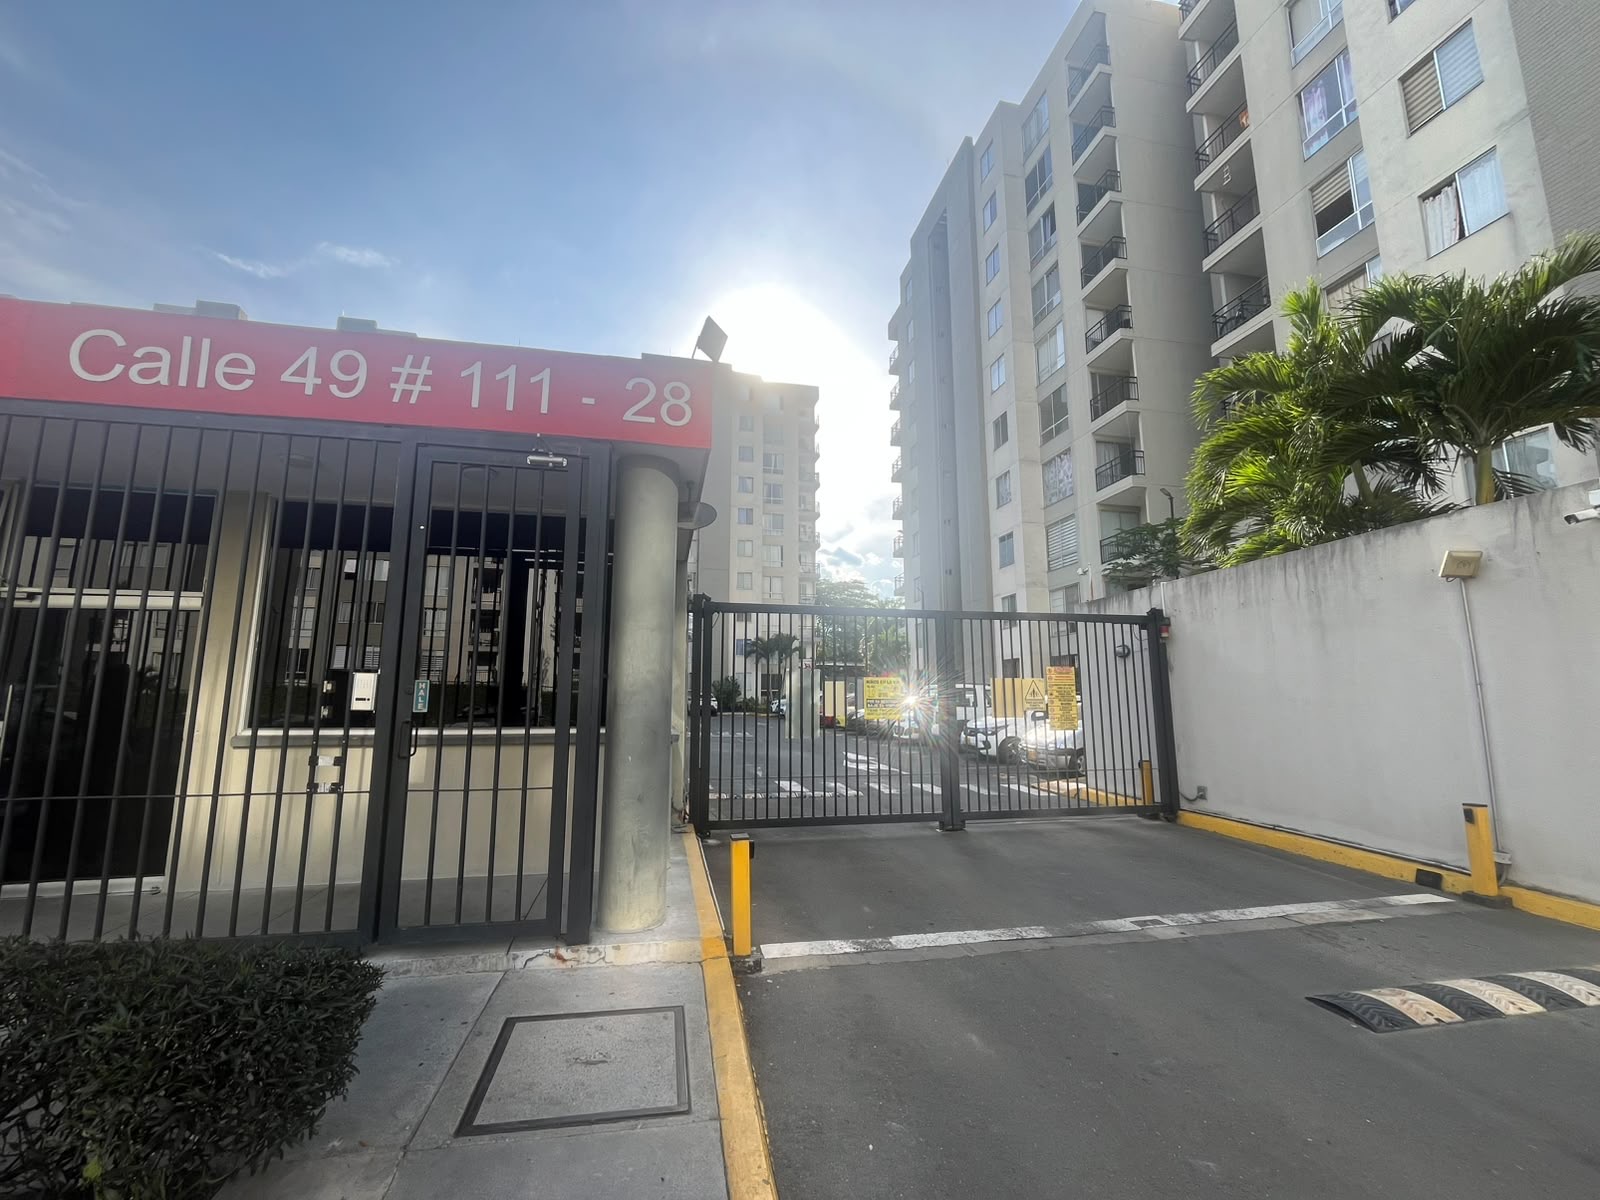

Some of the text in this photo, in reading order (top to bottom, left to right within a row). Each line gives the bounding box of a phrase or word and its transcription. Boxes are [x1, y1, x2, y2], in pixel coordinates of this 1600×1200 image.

[69, 328, 693, 427] Calle 49 # 111 - 28
[418, 682, 426, 710] HALE
